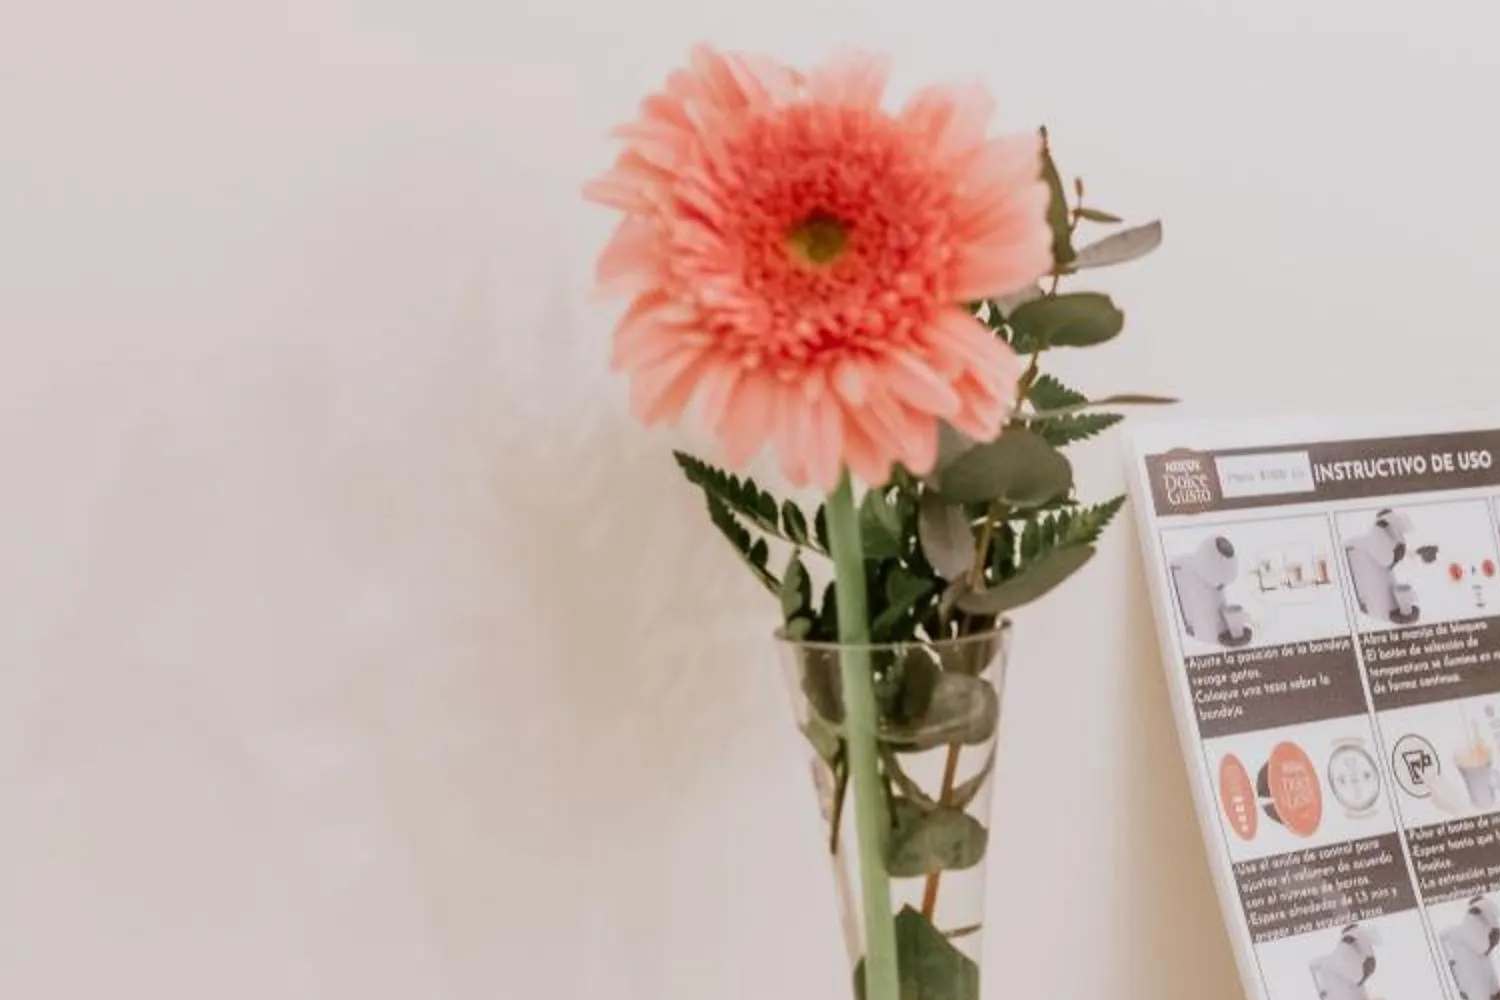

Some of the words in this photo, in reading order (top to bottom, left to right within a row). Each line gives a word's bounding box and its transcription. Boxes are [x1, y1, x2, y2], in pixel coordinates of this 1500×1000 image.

[1313, 455, 1427, 482] INSTRUCTIVO
[1431, 453, 1454, 473] DE
[1458, 449, 1492, 470] USO
